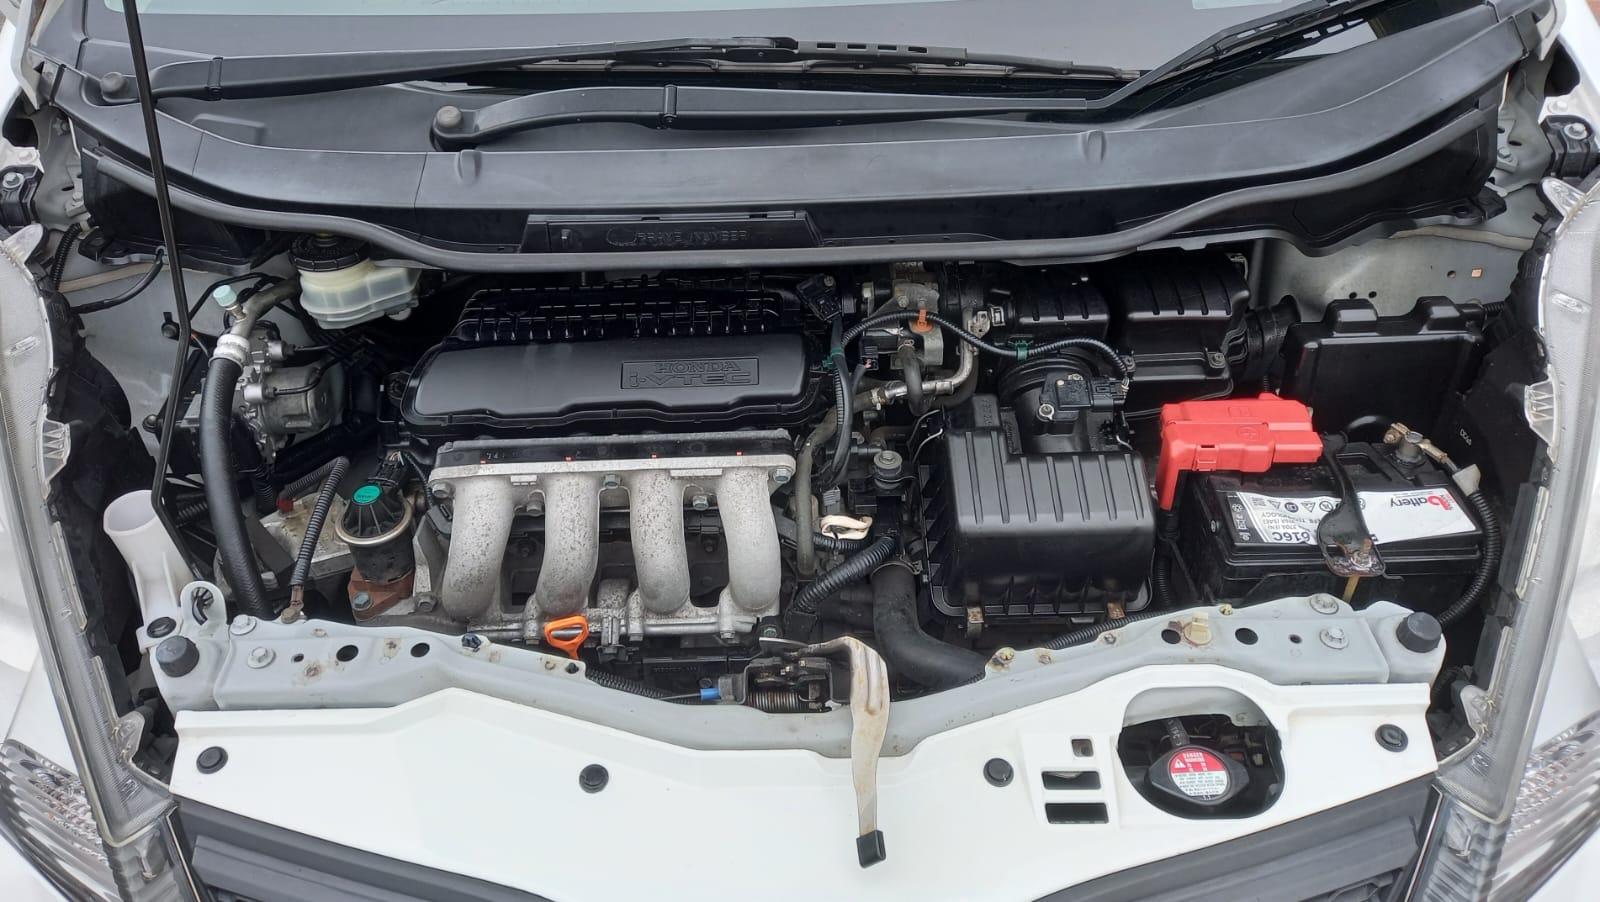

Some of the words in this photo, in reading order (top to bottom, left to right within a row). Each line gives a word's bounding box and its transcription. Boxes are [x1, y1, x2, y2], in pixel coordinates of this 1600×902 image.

[655, 361, 741, 374] HONDA
[1390, 495, 1450, 511] battery
[1271, 531, 1311, 541] 616C
